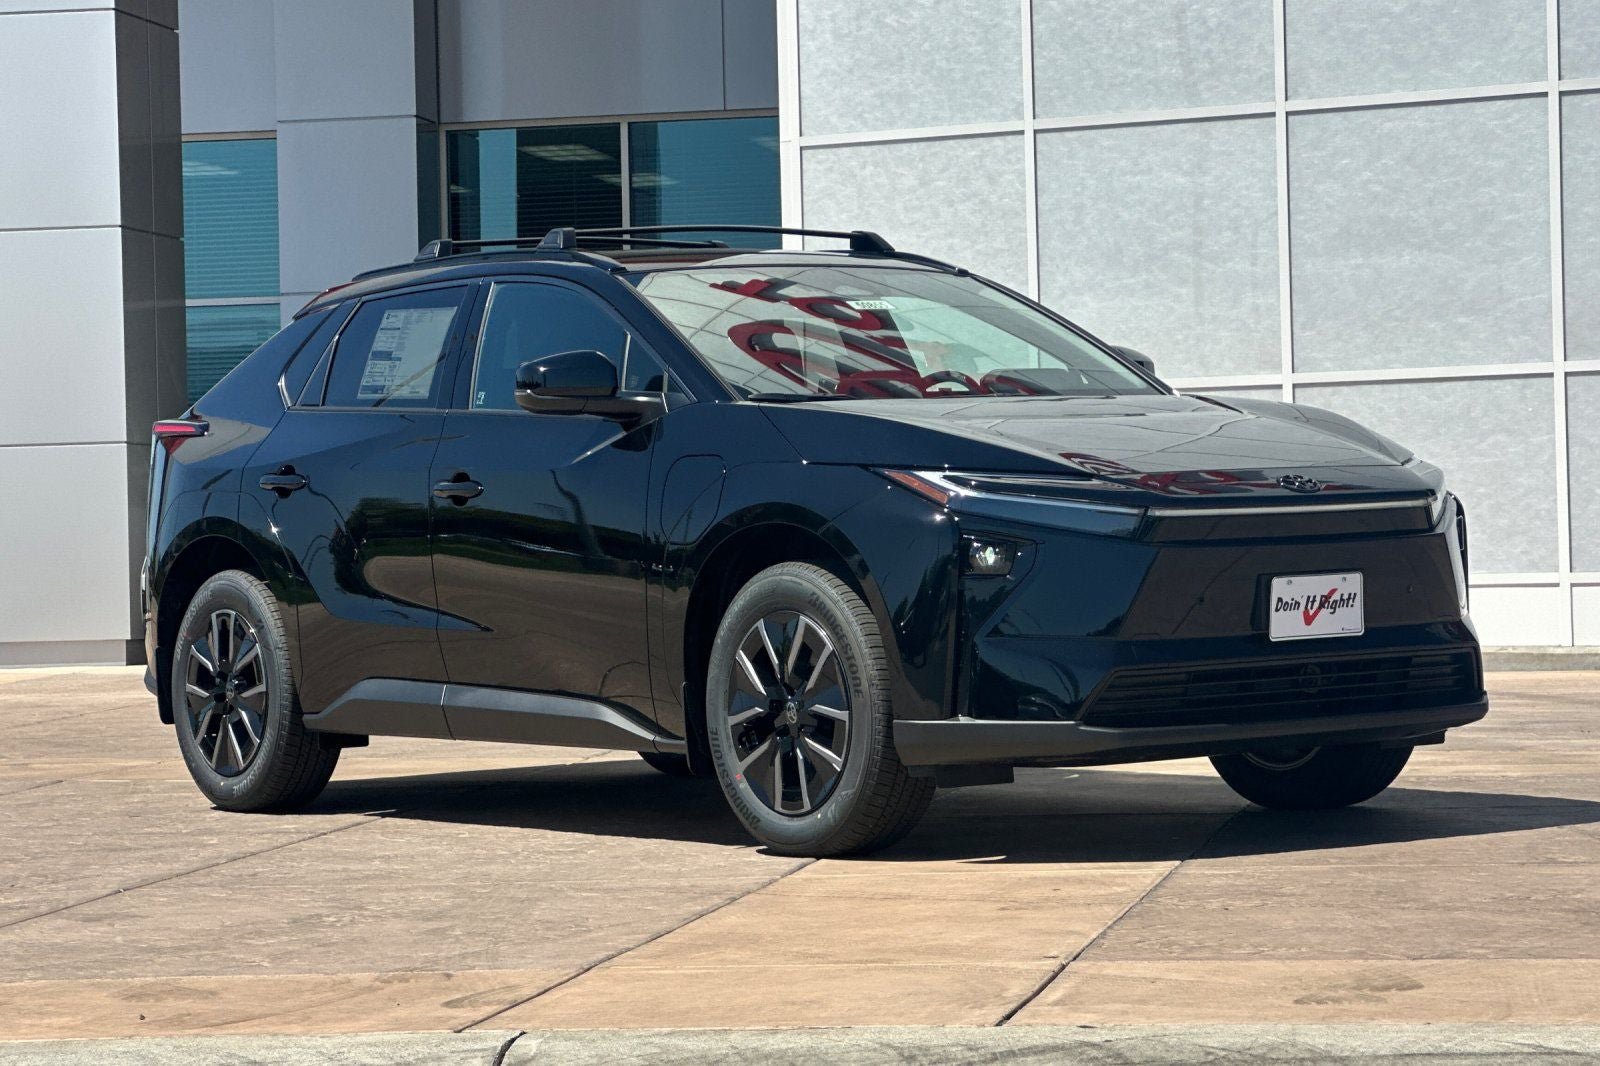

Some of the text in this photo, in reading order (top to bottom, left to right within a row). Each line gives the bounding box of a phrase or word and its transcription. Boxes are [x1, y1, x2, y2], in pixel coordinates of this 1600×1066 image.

[808, 591, 864, 699] BRIDGESTONE
[1275, 592, 1357, 615] Doin' It Right!
[710, 726, 765, 832] BRIDGESTONE
